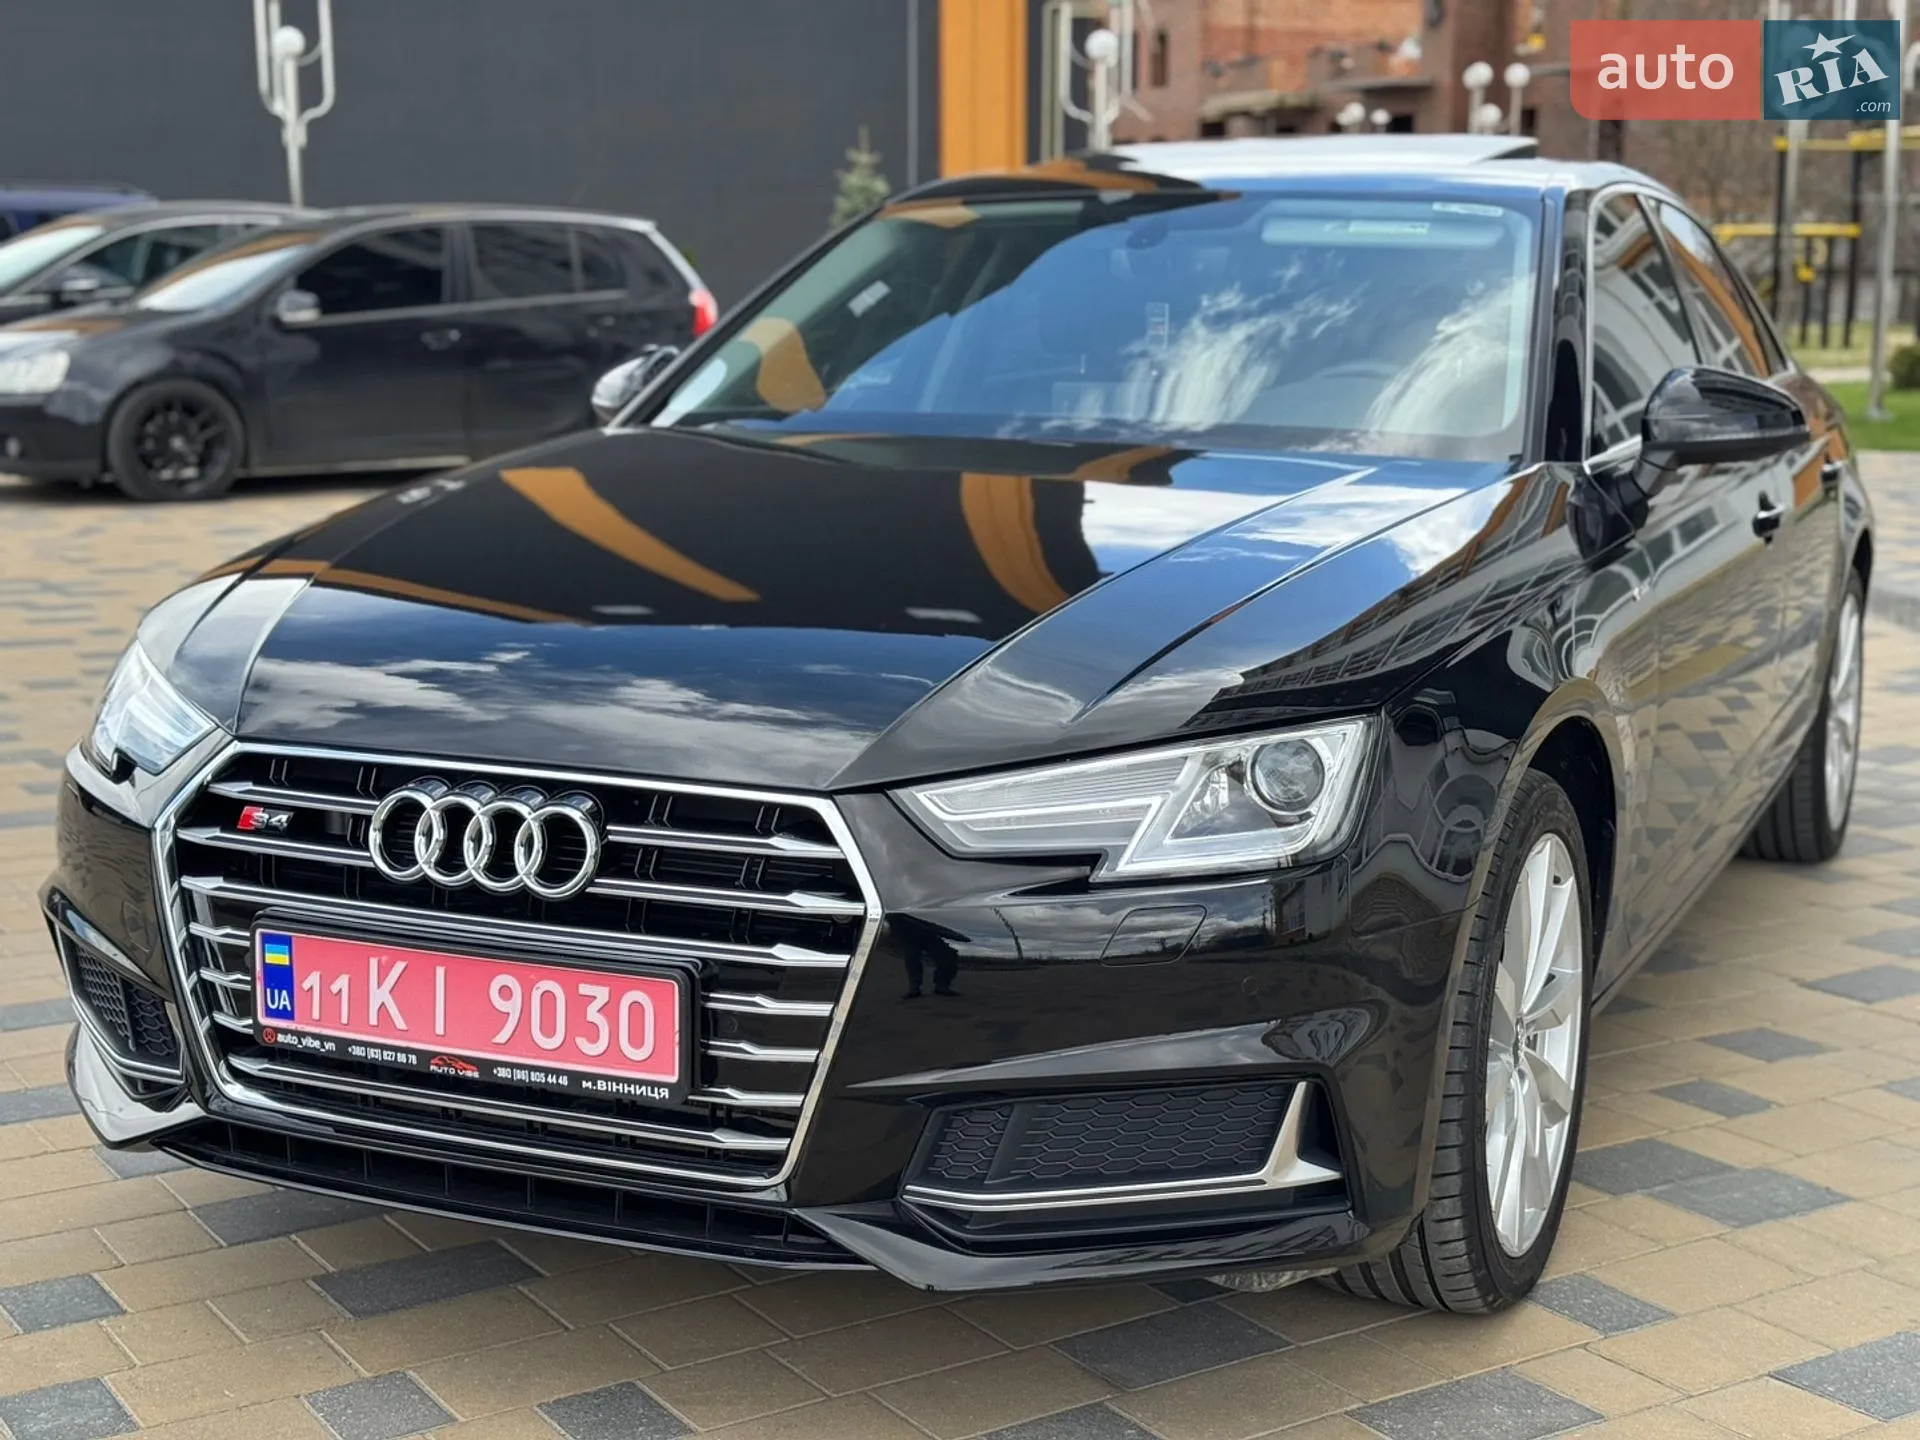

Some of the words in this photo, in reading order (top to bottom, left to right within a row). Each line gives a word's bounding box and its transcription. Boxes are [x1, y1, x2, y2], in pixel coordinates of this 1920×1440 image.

[248, 811, 290, 830] S4
[266, 987, 291, 1011] UA
[488, 973, 655, 1062] 9030
